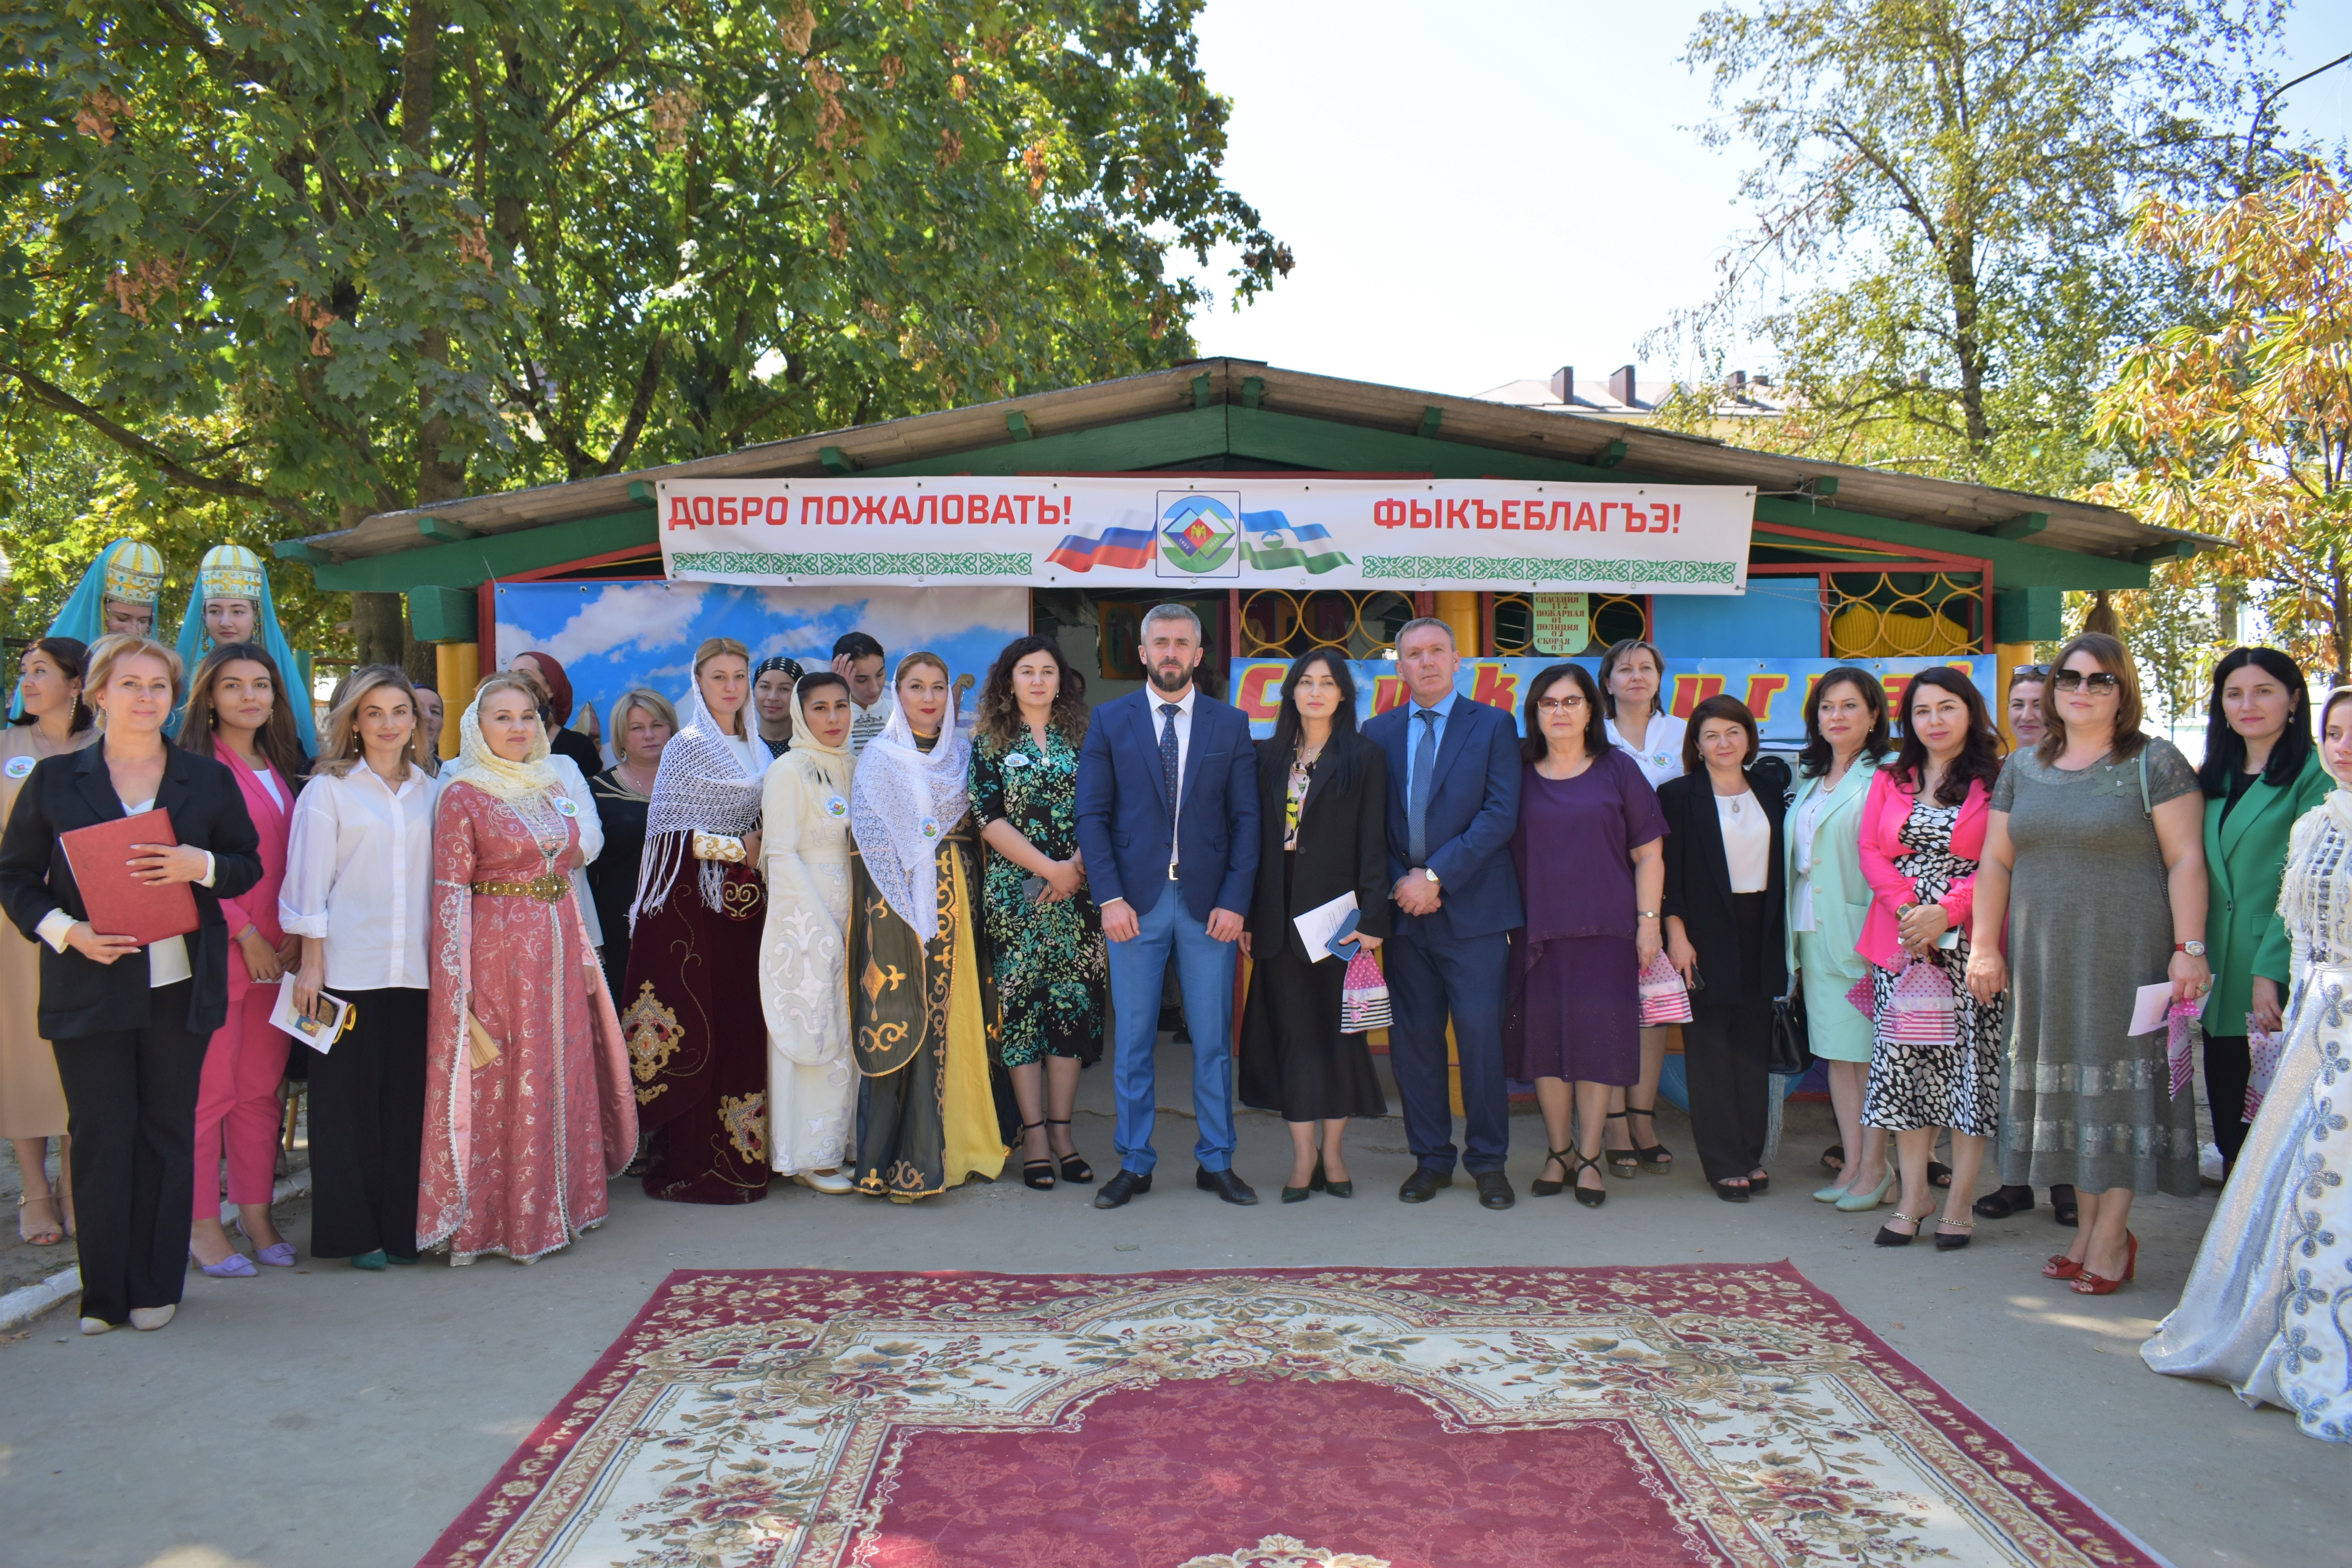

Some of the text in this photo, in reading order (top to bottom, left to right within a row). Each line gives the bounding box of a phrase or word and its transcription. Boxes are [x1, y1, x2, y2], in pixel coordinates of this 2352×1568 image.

[668, 494, 1071, 531] ДОБРО ПОЖАЛОВАТЬ!
[1374, 498, 1681, 534] ФЫКЪЕБЛАГЪЭ!
[1179, 538, 1190, 550] 1922
[1209, 537, 1220, 548] 2022
